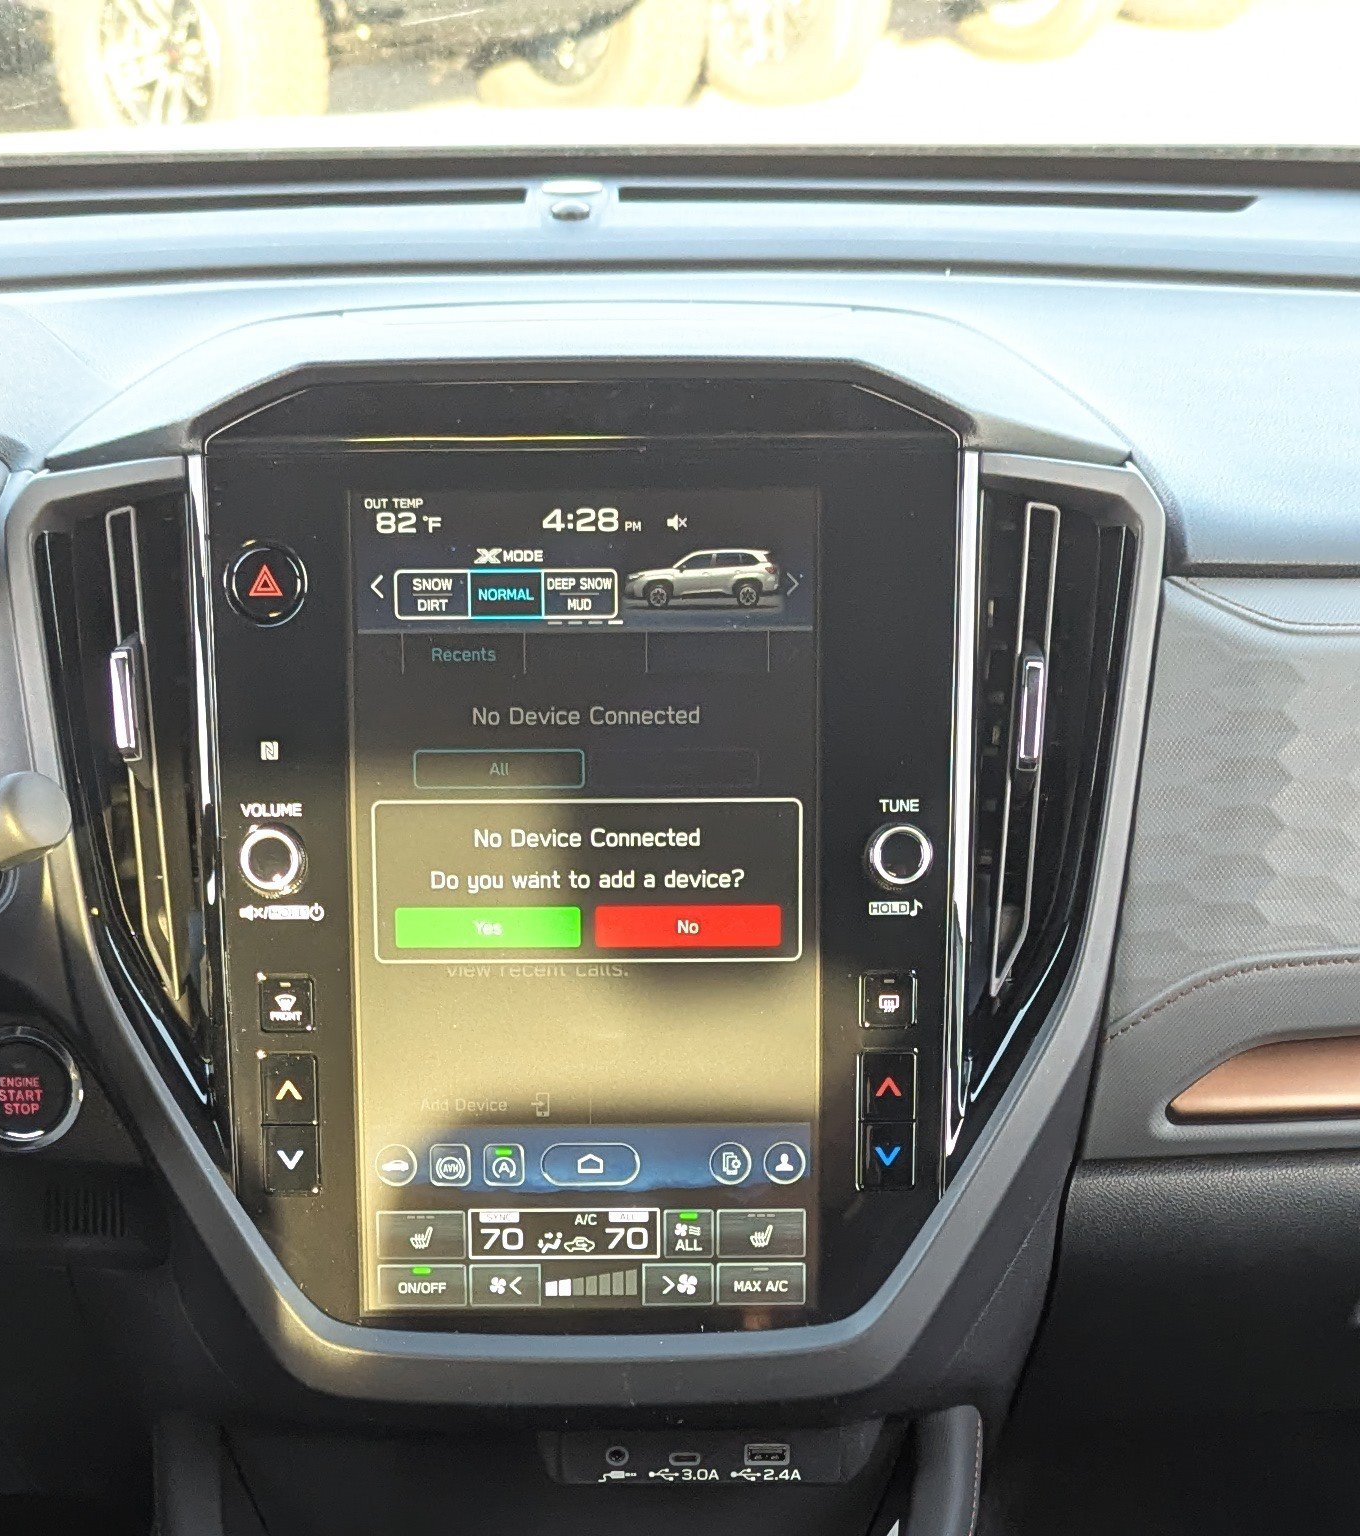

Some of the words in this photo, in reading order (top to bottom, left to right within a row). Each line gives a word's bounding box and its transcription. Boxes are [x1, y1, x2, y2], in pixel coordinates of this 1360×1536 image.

[364, 499, 388, 509] OUT
[392, 499, 423, 508] TEMP
[376, 512, 416, 533] 82
[542, 508, 619, 532] 4:28
[625, 521, 641, 532] PM
[412, 578, 452, 591] SNOW
[547, 578, 576, 590] DEEP
[580, 578, 612, 590] SNOW
[478, 589, 534, 600] NORMAL
[418, 599, 448, 612] DIRT
[568, 599, 591, 611] MUD
[431, 648, 496, 662] Recents
[472, 707, 500, 726] No
[510, 706, 580, 725] Device
[590, 706, 700, 725] Connected
[490, 763, 509, 776] All
[241, 803, 302, 817] VOLUME
[879, 799, 919, 812] TUNE
[474, 829, 502, 848] No
[511, 828, 581, 848] Device
[591, 827, 701, 848] Connected
[430, 870, 459, 890] Do
[468, 872, 503, 894] you
[513, 872, 560, 889] want
[569, 870, 590, 889] to
[599, 869, 635, 889] add
[644, 872, 656, 888] a
[664, 868, 745, 888] device?
[871, 904, 907, 913] HOLD
[678, 920, 699, 934] No
[0, 1077, 40, 1087] ENGINE
[4, 1103, 39, 1114] STOP
[455, 1098, 507, 1112] Device
[575, 1214, 598, 1227] A/C
[480, 1227, 524, 1251] 70
[605, 1227, 649, 1251] 70
[674, 1238, 702, 1252] ALL
[398, 1282, 447, 1295] ON/OFF
[734, 1280, 761, 1293] MAX
[766, 1279, 788, 1292] A/C
[682, 1469, 719, 1480] 3.0A
[764, 1469, 801, 1480] 2.4A
